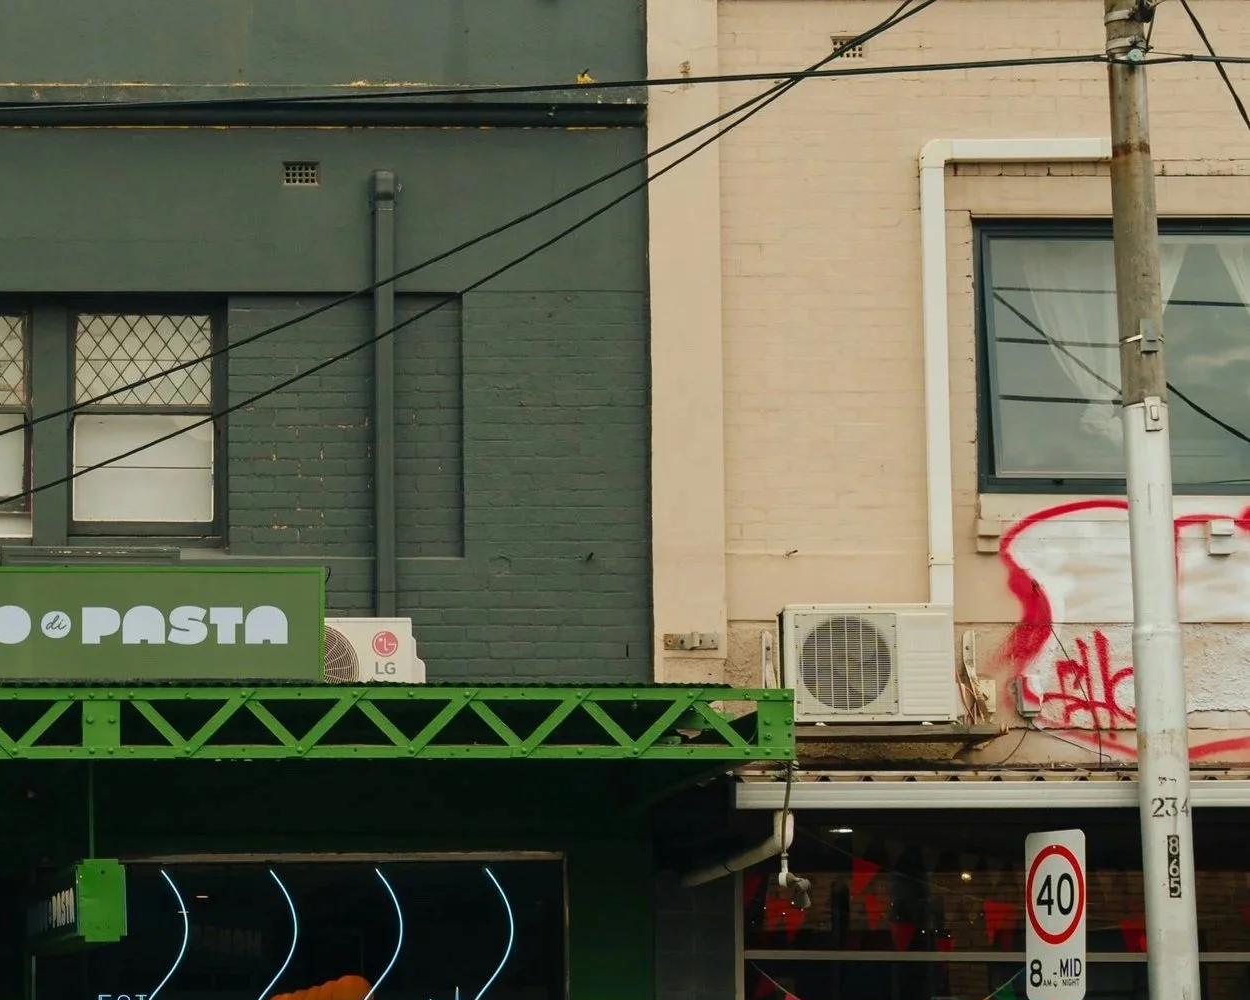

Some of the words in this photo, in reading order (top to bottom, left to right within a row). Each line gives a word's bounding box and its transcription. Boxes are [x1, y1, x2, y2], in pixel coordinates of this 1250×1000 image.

[45, 613, 68, 633] di
[81, 605, 289, 645] PASTA
[374, 661, 397, 676] LG
[1151, 797, 1190, 818] 234
[1168, 836, 1181, 897] 865
[52, 888, 75, 928] PASTA
[1036, 872, 1075, 916] 40
[1029, 958, 1043, 988] 8
[1059, 958, 1082, 978] MID
[1062, 978, 1081, 987] NIGHT
